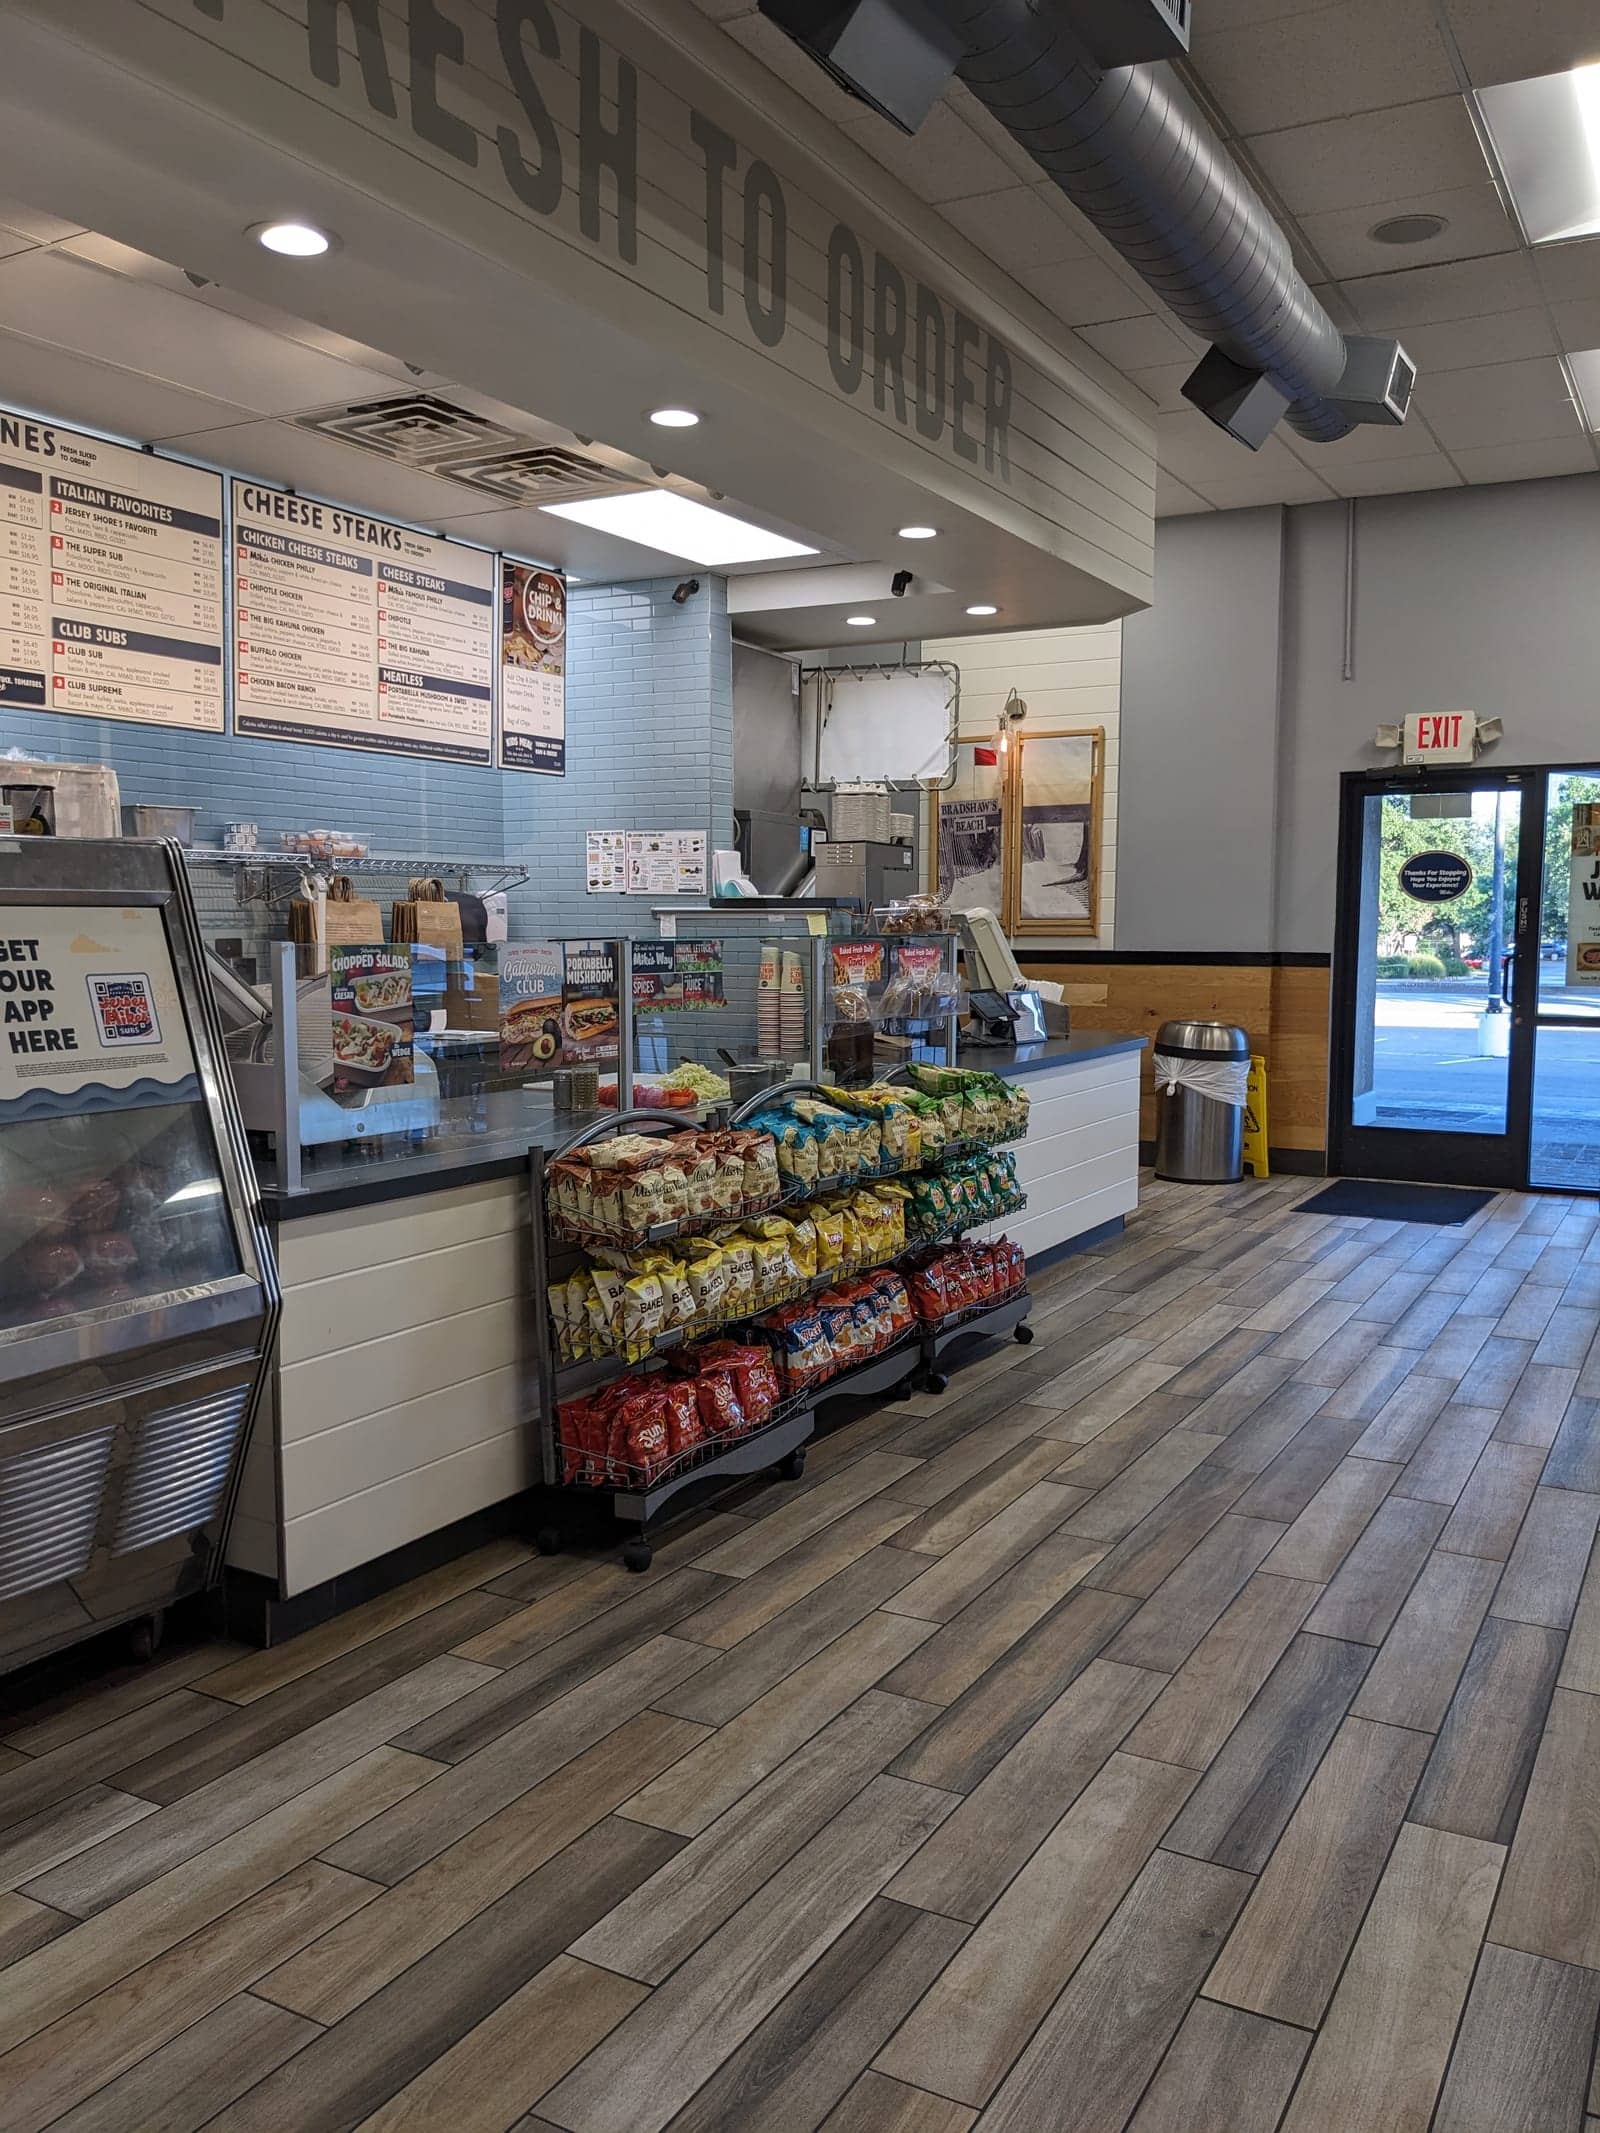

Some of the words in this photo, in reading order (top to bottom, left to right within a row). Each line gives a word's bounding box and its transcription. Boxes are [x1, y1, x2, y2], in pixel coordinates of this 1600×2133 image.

[690, 109, 787, 348] TO
[827, 222, 1013, 486] ORDER
[57, 481, 106, 507] ITALIAN
[110, 495, 173, 522] FAVORITES
[64, 506, 90, 520] JERSEY
[125, 522, 158, 537] FAVORITE
[243, 488, 323, 530] CHEESE
[333, 513, 402, 551] STEAKS
[66, 542, 80, 552] THE
[82, 545, 107, 558] SUPER
[109, 549, 123, 561] SUB
[243, 530, 286, 551] CHICKEN
[288, 541, 323, 561] CHEESE
[325, 552, 359, 570] STEAKS
[270, 557, 295, 569] CHICKEN
[296, 562, 316, 574] PHILLY
[382, 565, 414, 584] CHEESE
[415, 575, 446, 592] STEAKS
[66, 577, 80, 588] THE
[83, 580, 118, 595] ORIGINAL
[120, 588, 147, 601] ITALIAN
[249, 582, 278, 596] CHIPOTLE
[279, 587, 303, 601] CHICKEN
[529, 590, 552, 608] CHIP
[554, 598, 562, 610] &
[250, 613, 262, 624] THE
[263, 616, 274, 626] BIG
[275, 618, 300, 631] KAHUNA
[301, 622, 325, 635] CHICKEN
[388, 613, 412, 625] CHIPOTLE
[528, 605, 562, 626] DRINK!
[59, 622, 92, 640] CLUB
[96, 628, 128, 646] SUBS
[67, 646, 86, 657] CLUB
[88, 650, 103, 660] SUB
[250, 645, 277, 657] BUFFALO
[278, 648, 302, 661] CHICKEN
[388, 642, 398, 650] THE
[67, 680, 86, 691] CLUB
[88, 683, 122, 696] SUPREME
[250, 676, 275, 688] CHICKEN
[276, 678, 296, 690] BACON
[297, 682, 317, 694] RANCH
[383, 670, 424, 687] MEATLESS
[1417, 715, 1463, 750] EXIT
[941, 800, 998, 816] BRADSHAW'S
[955, 819, 985, 832] BEACH
[839, 946, 852, 955] Baked
[852, 946, 863, 954] Fresh
[331, 954, 374, 972] CHOPPED
[376, 953, 409, 969] SALADS
[503, 957, 557, 983] California
[566, 957, 613, 970] PORTABELLA
[633, 951, 656, 966] Mike's
[656, 952, 673, 970] Way
[566, 969, 614, 984] MUSHROOM
[334, 991, 354, 1000] CAESAR
[516, 979, 545, 994] CLUB
[633, 980, 655, 994] SPICES
[5, 999, 54, 1023] APP
[8, 1028, 79, 1054] HERE
[730, 1262, 755, 1274] BAKED
[700, 1275, 724, 1296] BAKED
[639, 1424, 666, 1448] Sun
